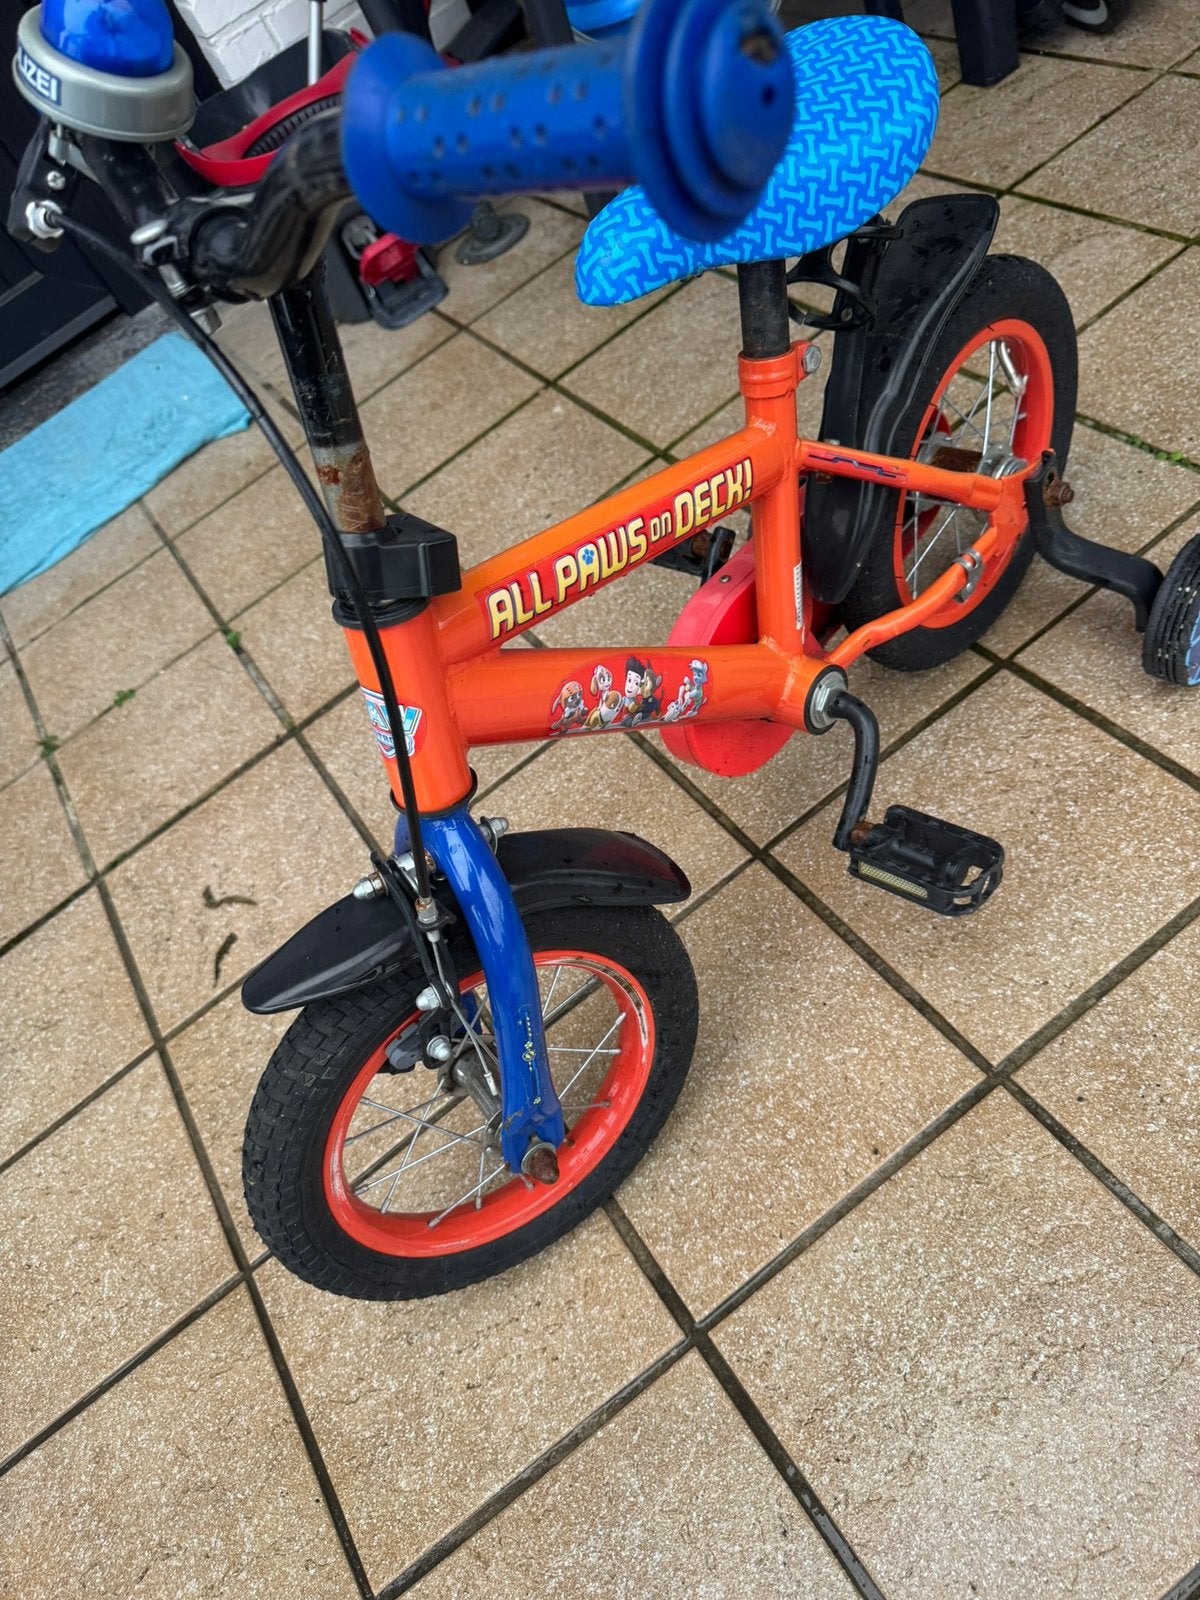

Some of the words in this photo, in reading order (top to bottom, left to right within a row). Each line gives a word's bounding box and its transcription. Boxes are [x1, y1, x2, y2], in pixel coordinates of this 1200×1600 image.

[486, 571, 552, 640] ALL
[554, 517, 648, 604] PAWS
[650, 511, 672, 543] on
[673, 457, 753, 539] DECK!
